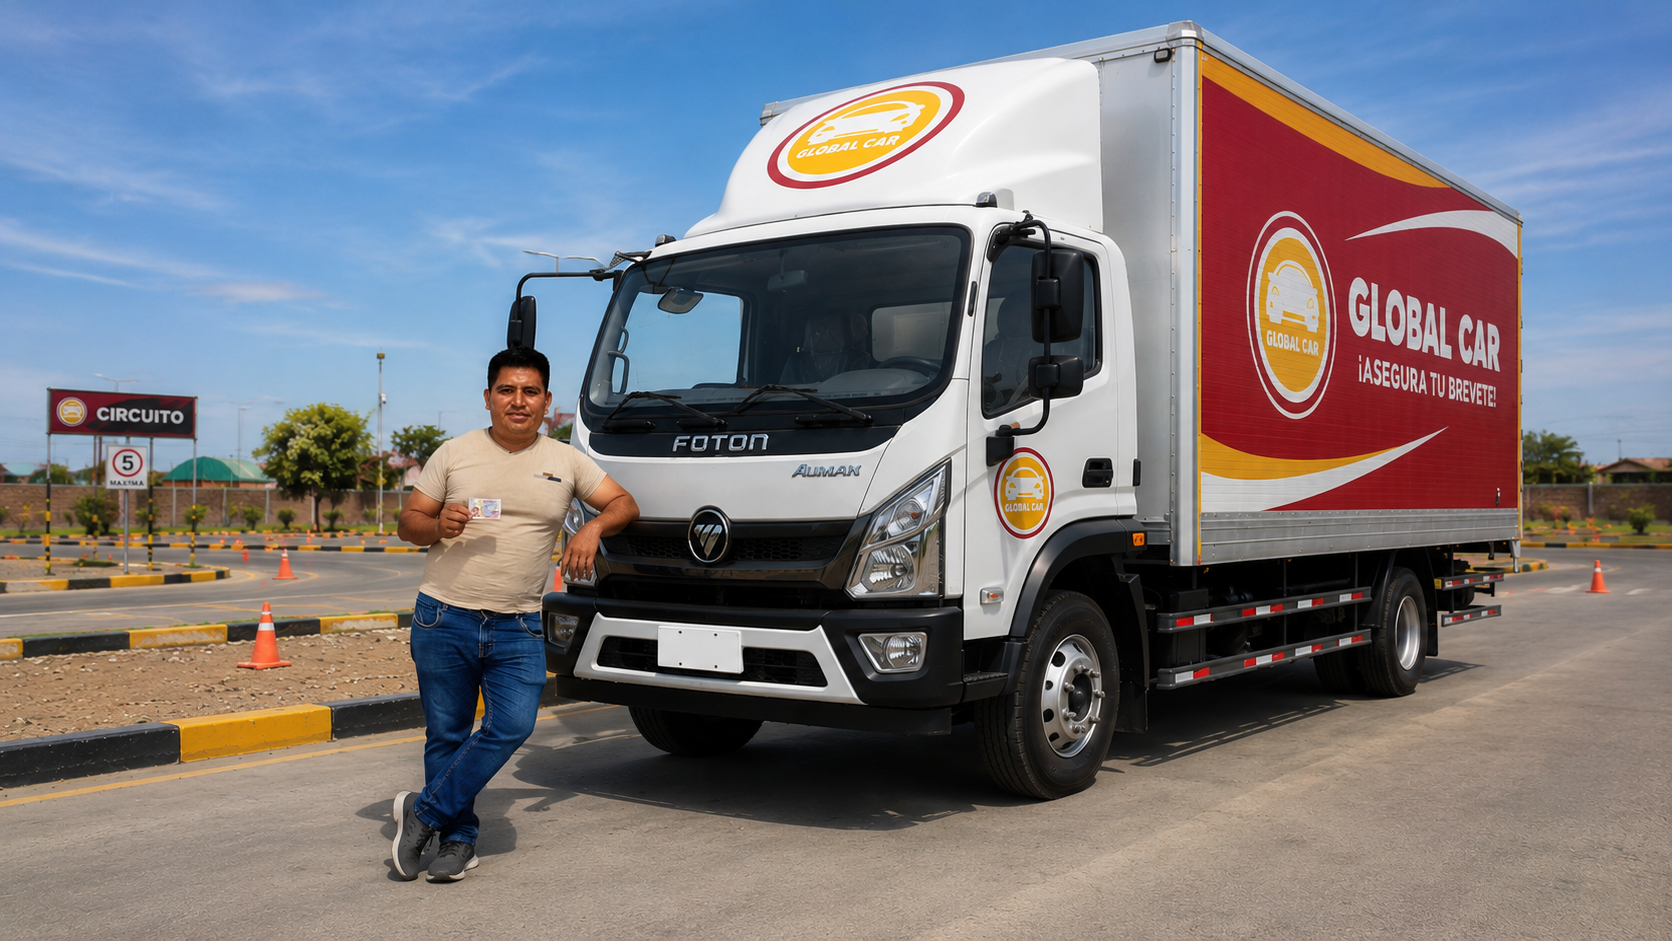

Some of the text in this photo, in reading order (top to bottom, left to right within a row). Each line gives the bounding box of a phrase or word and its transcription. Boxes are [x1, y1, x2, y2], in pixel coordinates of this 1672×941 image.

[796, 135, 900, 159] GLOBAL CAR
[1349, 277, 1501, 372] GLOBAL CAR
[1266, 330, 1319, 356] GLOBAL CAR
[1358, 354, 1497, 408] ¡ASEGURA TU BREVETE!
[96, 407, 185, 425] CIRCUITO
[672, 433, 769, 452] FOTON
[122, 455, 134, 471] 5
